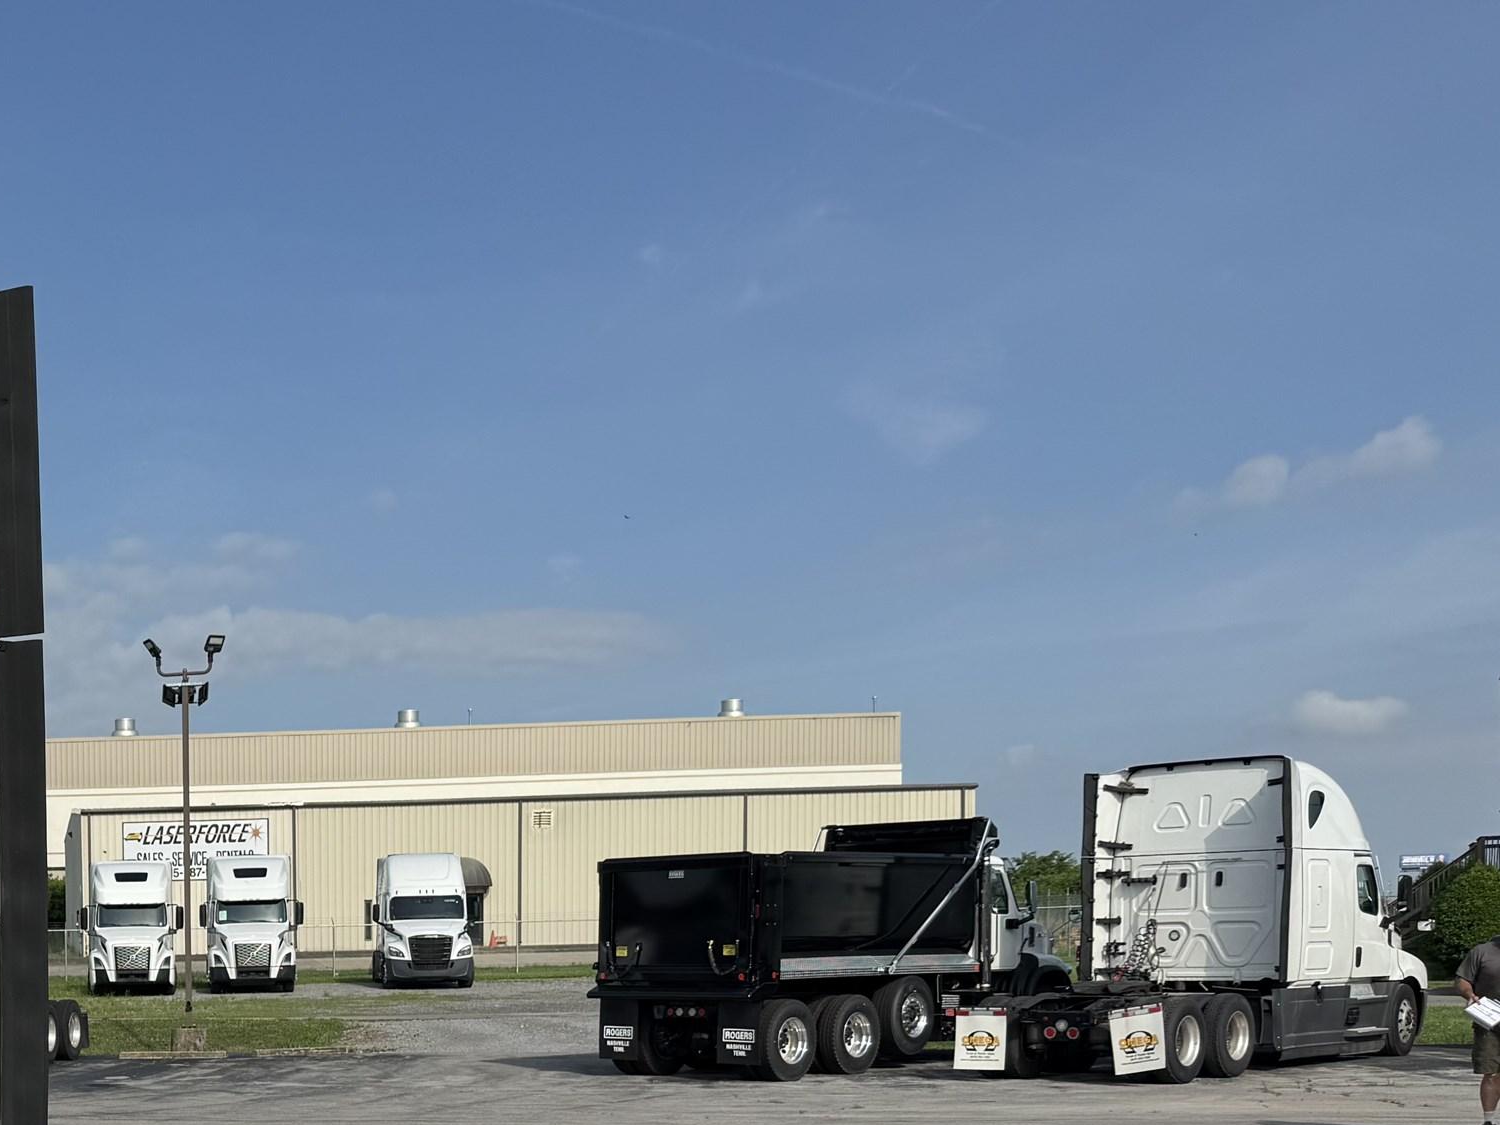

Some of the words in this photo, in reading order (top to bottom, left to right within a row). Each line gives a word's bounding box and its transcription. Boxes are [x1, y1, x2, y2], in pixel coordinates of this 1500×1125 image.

[143, 824, 251, 845] LASERFORCE
[172, 851, 207, 866] SEVICE
[605, 1028, 631, 1037] ROGERS
[724, 1031, 753, 1040] ROGERS
